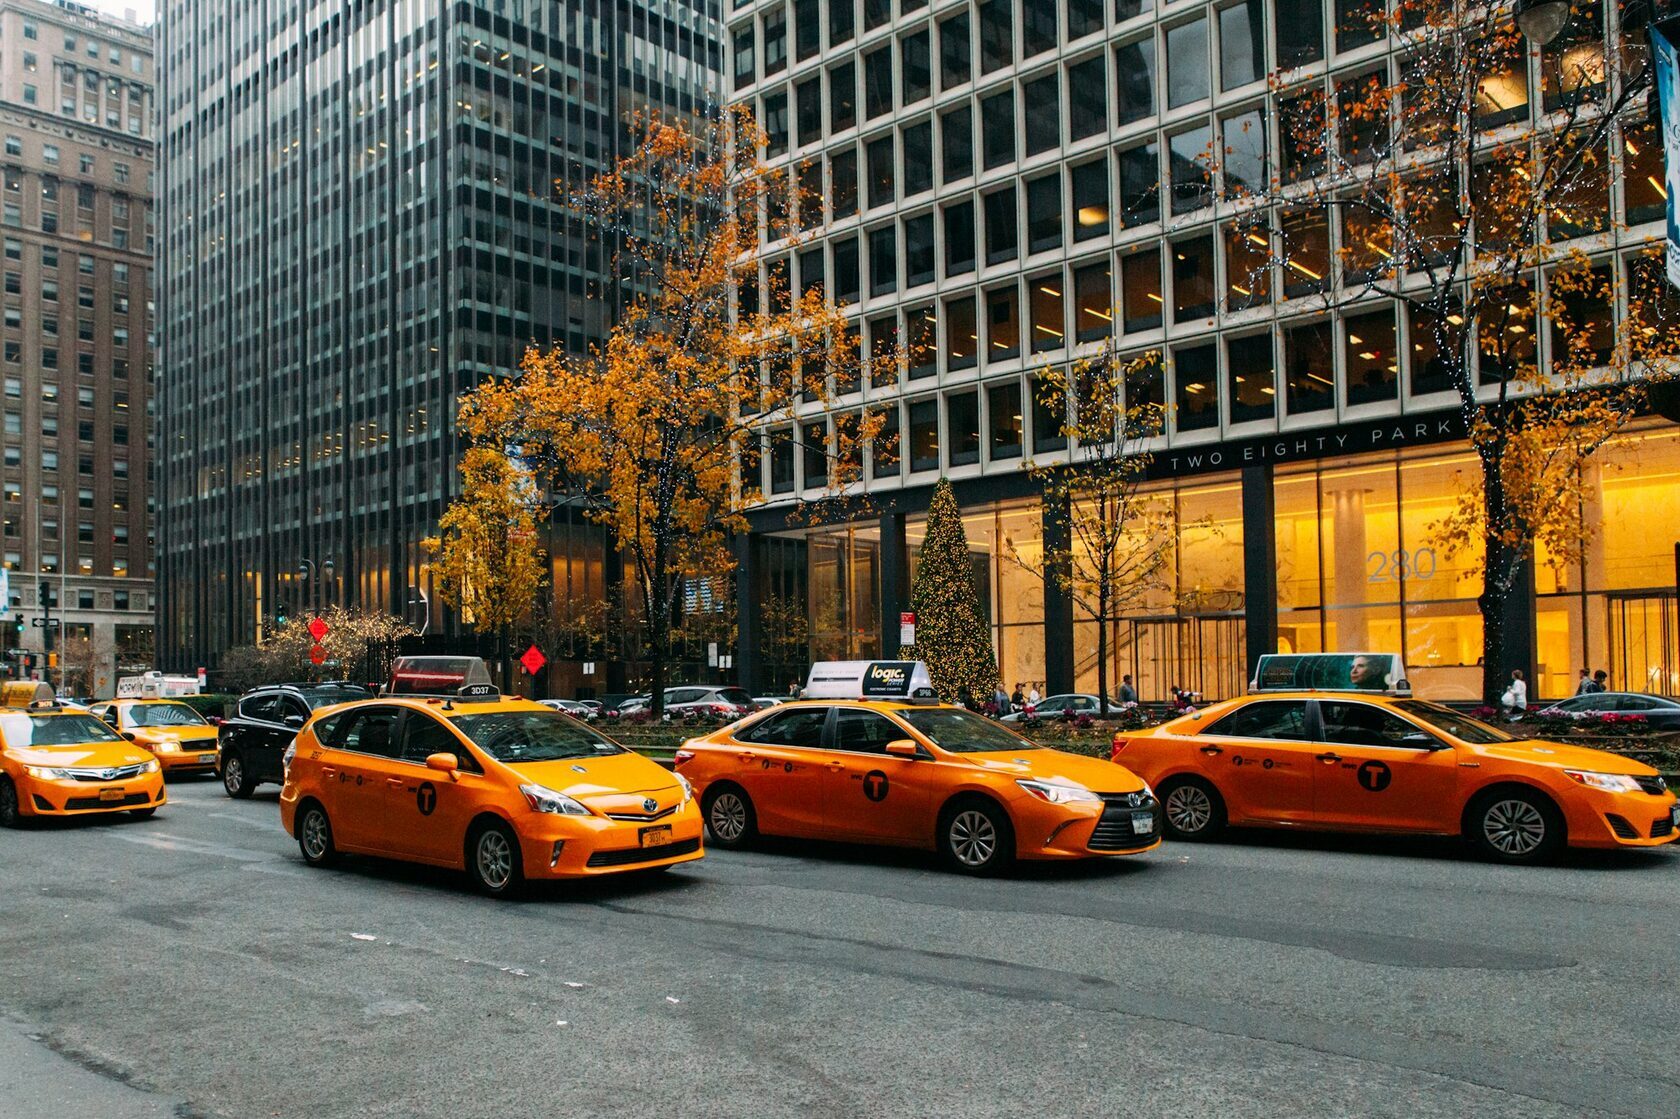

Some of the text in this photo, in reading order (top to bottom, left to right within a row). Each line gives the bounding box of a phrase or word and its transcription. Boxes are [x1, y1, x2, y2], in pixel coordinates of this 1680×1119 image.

[1170, 419, 1451, 470] TWO EIGHTY PARK
[1367, 547, 1437, 582] 280
[471, 686, 489, 695] 3D37
